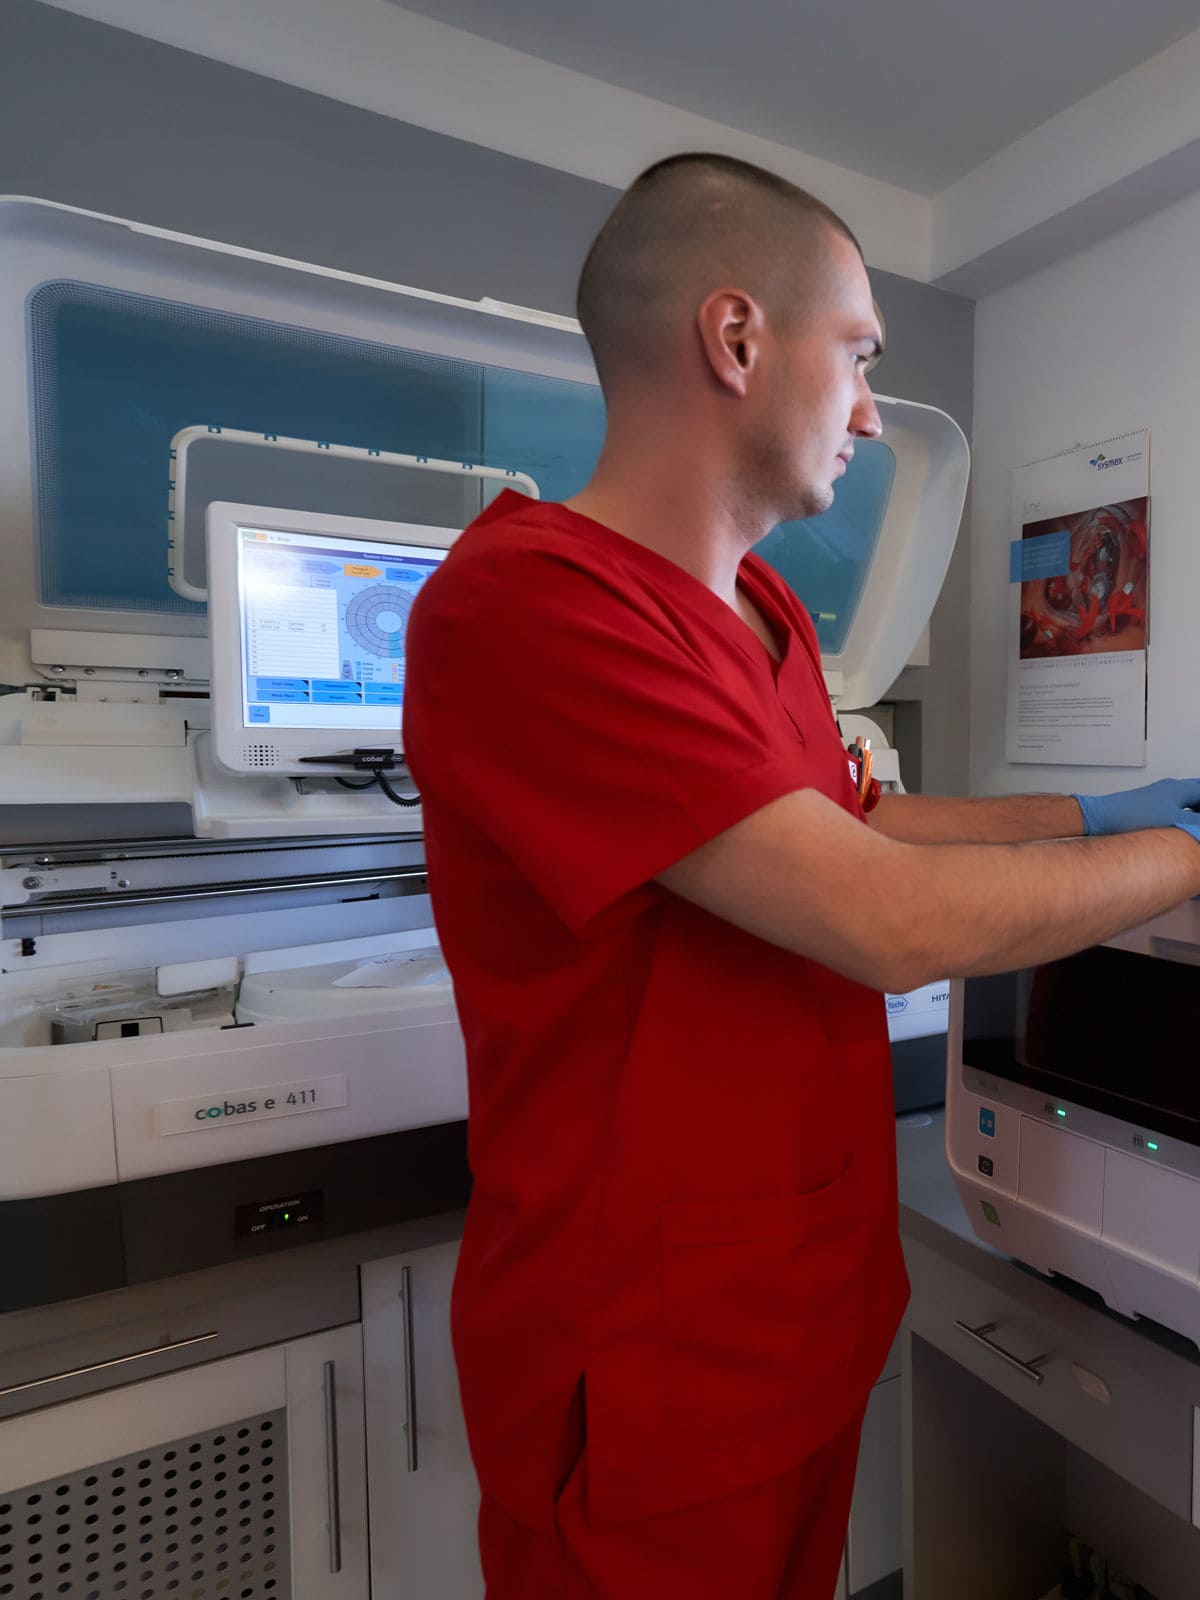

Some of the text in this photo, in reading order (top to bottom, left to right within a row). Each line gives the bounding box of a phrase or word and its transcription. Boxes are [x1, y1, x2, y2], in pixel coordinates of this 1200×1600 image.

[1097, 456, 1123, 471] sysmex
[362, 754, 384, 762] cobas
[195, 1089, 316, 1121] cobas e 411
[259, 1199, 300, 1212] OPERATION
[251, 1224, 266, 1232] OFF
